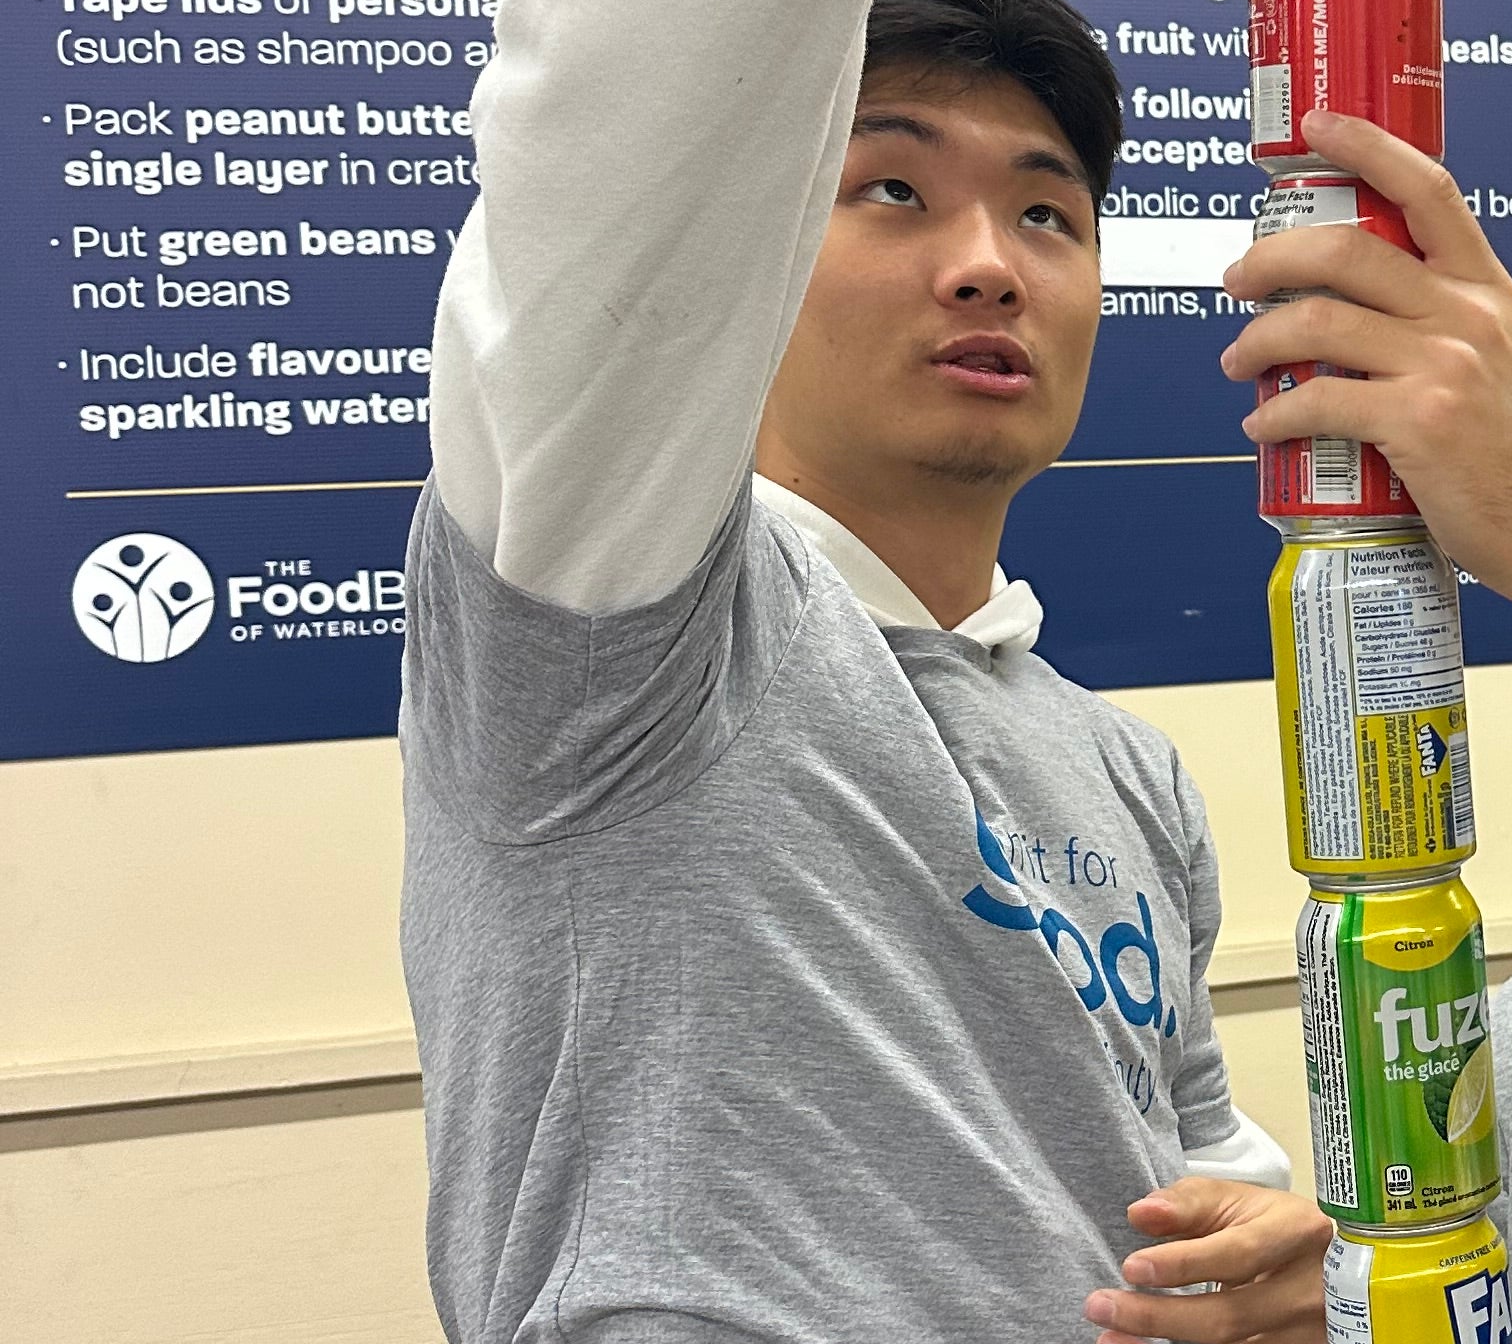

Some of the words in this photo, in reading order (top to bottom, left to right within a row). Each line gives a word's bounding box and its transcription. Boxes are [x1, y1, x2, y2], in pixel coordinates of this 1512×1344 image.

[57, 29, 181, 67] (such
[194, 36, 246, 65] as
[257, 32, 453, 72] shampoo
[1115, 22, 1195, 56] fruit
[1203, 27, 1250, 56] wit
[1132, 87, 1250, 120] followi
[65, 102, 172, 136] Pack
[185, 103, 345, 143] peanut
[357, 102, 472, 135] butte
[1119, 136, 1253, 171] ccepte
[64, 151, 202, 195] single
[215, 152, 329, 194] layer
[341, 153, 376, 186] in
[1101, 186, 1199, 216] oholic
[1209, 194, 1241, 216] or
[73, 226, 148, 259] Put
[159, 228, 288, 266] green
[300, 222, 436, 256] beans
[72, 277, 144, 309] not
[156, 274, 291, 308] beans
[1101, 287, 1208, 320] amins,
[80, 345, 237, 380] Include
[248, 343, 432, 376] flavoure
[79, 392, 292, 439] sparkling
[302, 398, 431, 426] water
[265, 560, 311, 576] THE
[1351, 550, 1399, 563] Nutrition
[1401, 547, 1426, 559] Facts
[1351, 565, 1390, 577] Valeur
[1394, 561, 1434, 573] nutritive
[228, 570, 407, 619] FoodB
[1353, 604, 1394, 615] Calories
[231, 625, 264, 642] OF
[273, 617, 407, 641] WATERLOO
[1416, 723, 1437, 778] FANTA
[1064, 836, 1118, 888] for
[1394, 938, 1435, 953] Citron
[1384, 1060, 1415, 1082] thé
[1417, 1052, 1461, 1082] glacé
[1391, 1169, 1408, 1181] 110
[1422, 1186, 1455, 1197] Citron
[1387, 1199, 1402, 1211] 341
[1440, 1250, 1475, 1268] CAFFEINE
